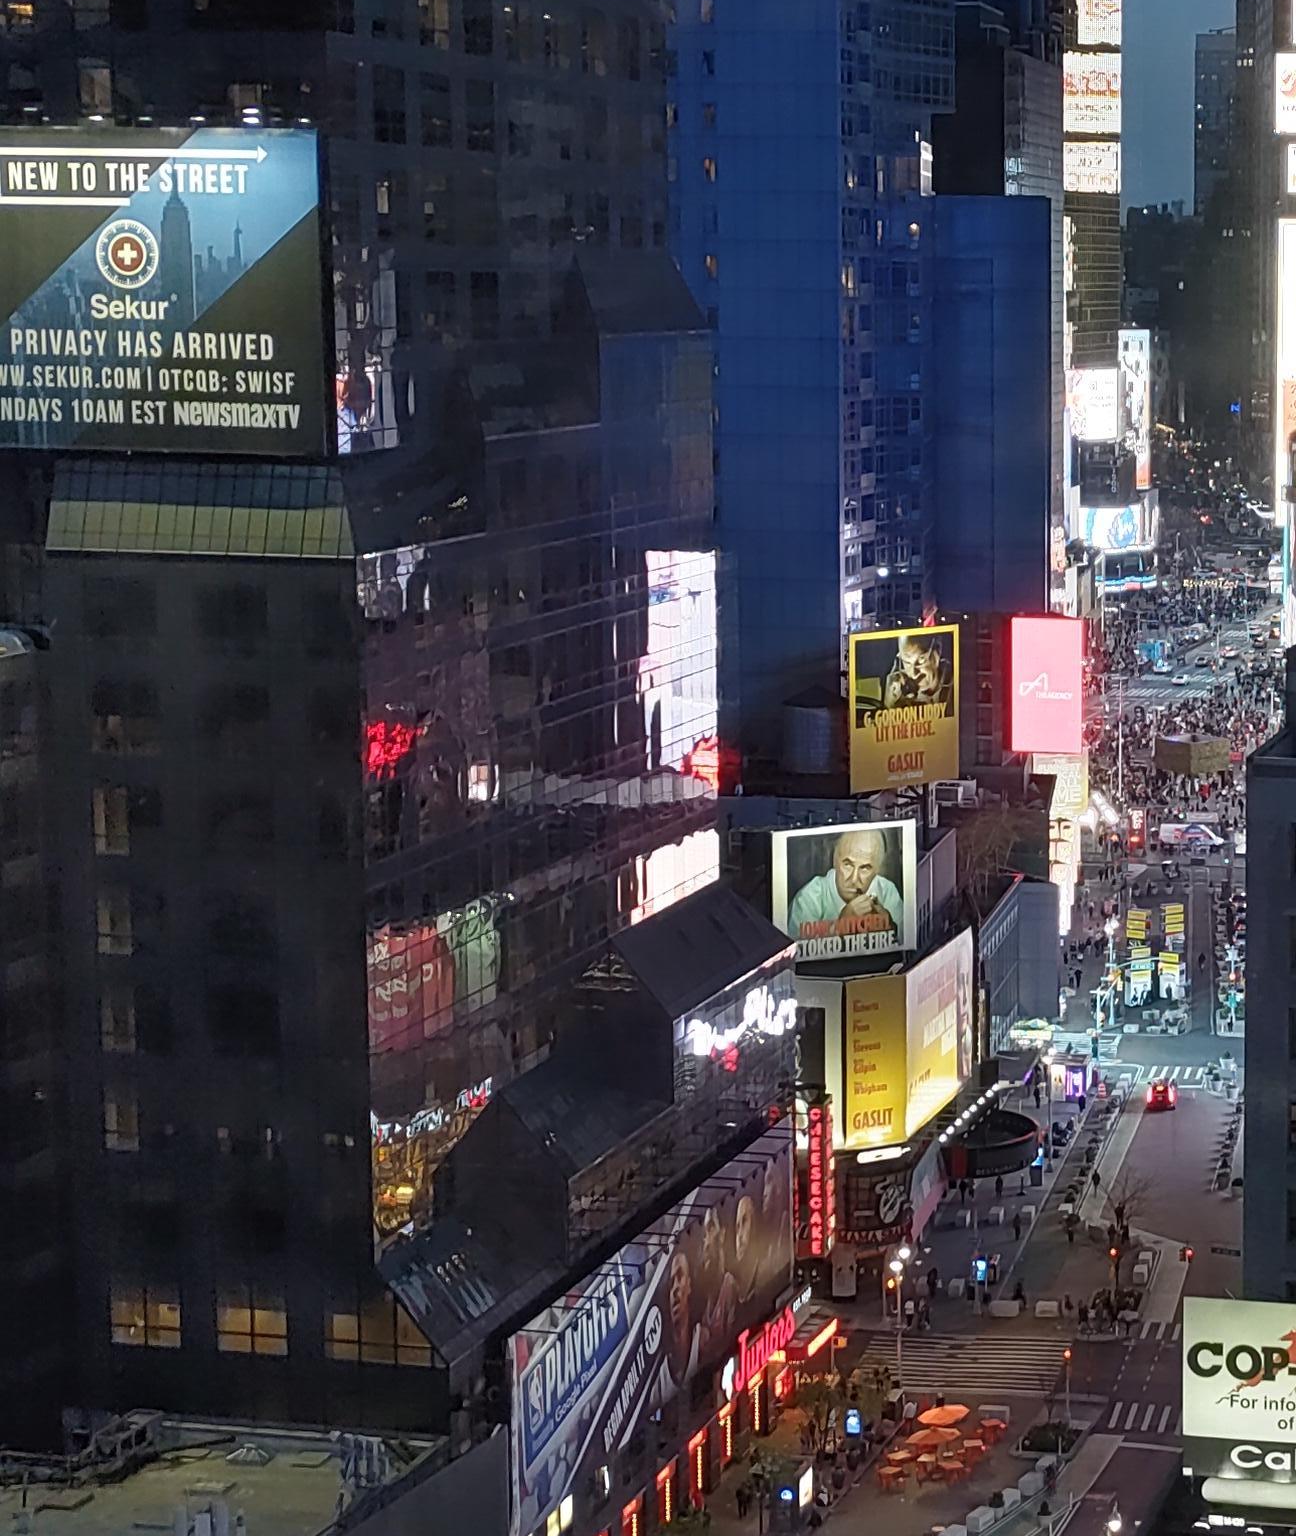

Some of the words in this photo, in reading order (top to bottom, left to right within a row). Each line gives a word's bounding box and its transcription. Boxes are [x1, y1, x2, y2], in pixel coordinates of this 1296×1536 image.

[8, 161, 58, 191] NEW
[68, 162, 97, 192] TO
[105, 163, 150, 192] THE
[159, 164, 249, 194] STREET
[90, 293, 169, 320] Sekur
[10, 328, 108, 357] PRIVACY
[118, 331, 162, 358] HAS
[173, 332, 274, 361] ARRIVED
[159, 368, 229, 393] OTCQB:
[236, 370, 296, 395] SWISF
[71, 399, 124, 425] 10AM
[132, 401, 166, 426] EST
[875, 705, 918, 727] GORDON
[919, 702, 948, 720] LIDDY
[892, 722, 909, 741] THE
[910, 720, 936, 739] FUSE.
[887, 751, 925, 773] GASLIT
[796, 936, 842, 958] STOKED
[843, 933, 867, 953] THE
[868, 930, 899, 950] FIRE.
[853, 1107, 893, 1130] GASLIT
[808, 1107, 824, 1255] CHEESECAKE
[545, 1270, 619, 1414] PLAYOFFS
[645, 1312, 661, 1349] TNT
[621, 1362, 640, 1413] APRIL
[555, 1384, 581, 1422] Google
[1229, 1394, 1258, 1410] For
[1277, 1416, 1295, 1431] of
